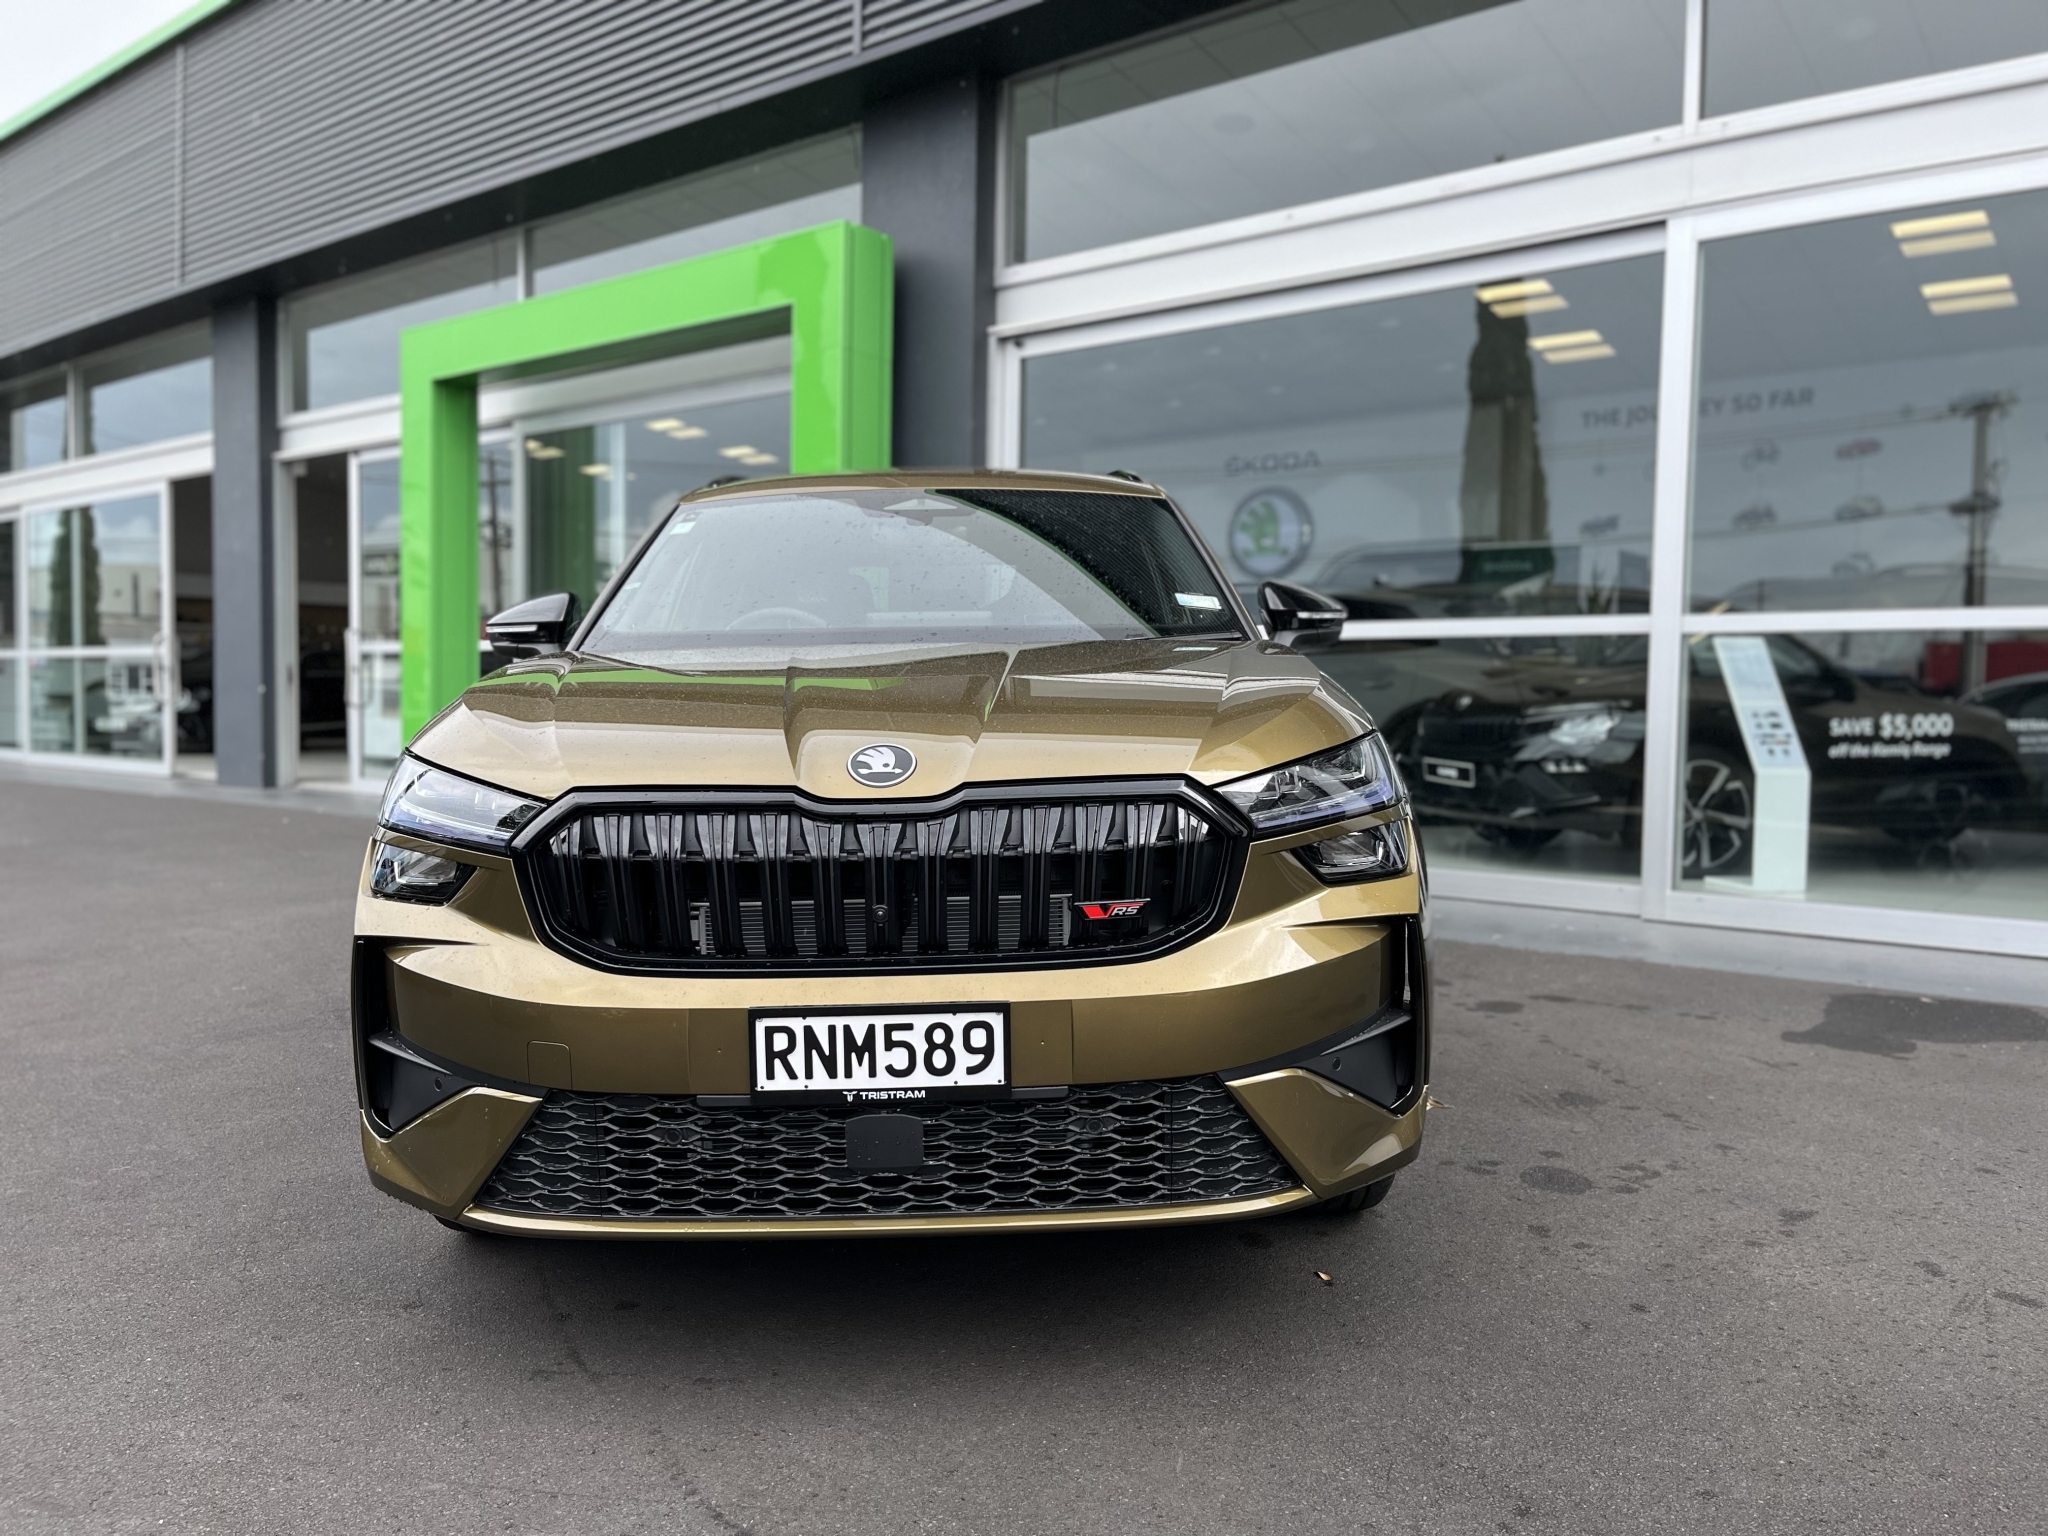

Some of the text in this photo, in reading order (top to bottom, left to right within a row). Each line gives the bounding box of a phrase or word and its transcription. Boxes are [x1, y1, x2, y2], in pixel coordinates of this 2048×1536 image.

[1582, 406, 1621, 428] THE
[1731, 392, 1762, 415] SO
[1768, 387, 1815, 410] FAR
[1829, 712, 1954, 741] SAVE $5,000
[764, 1020, 995, 1081] RNM589
[859, 1089, 926, 1101] TRISTRAM
